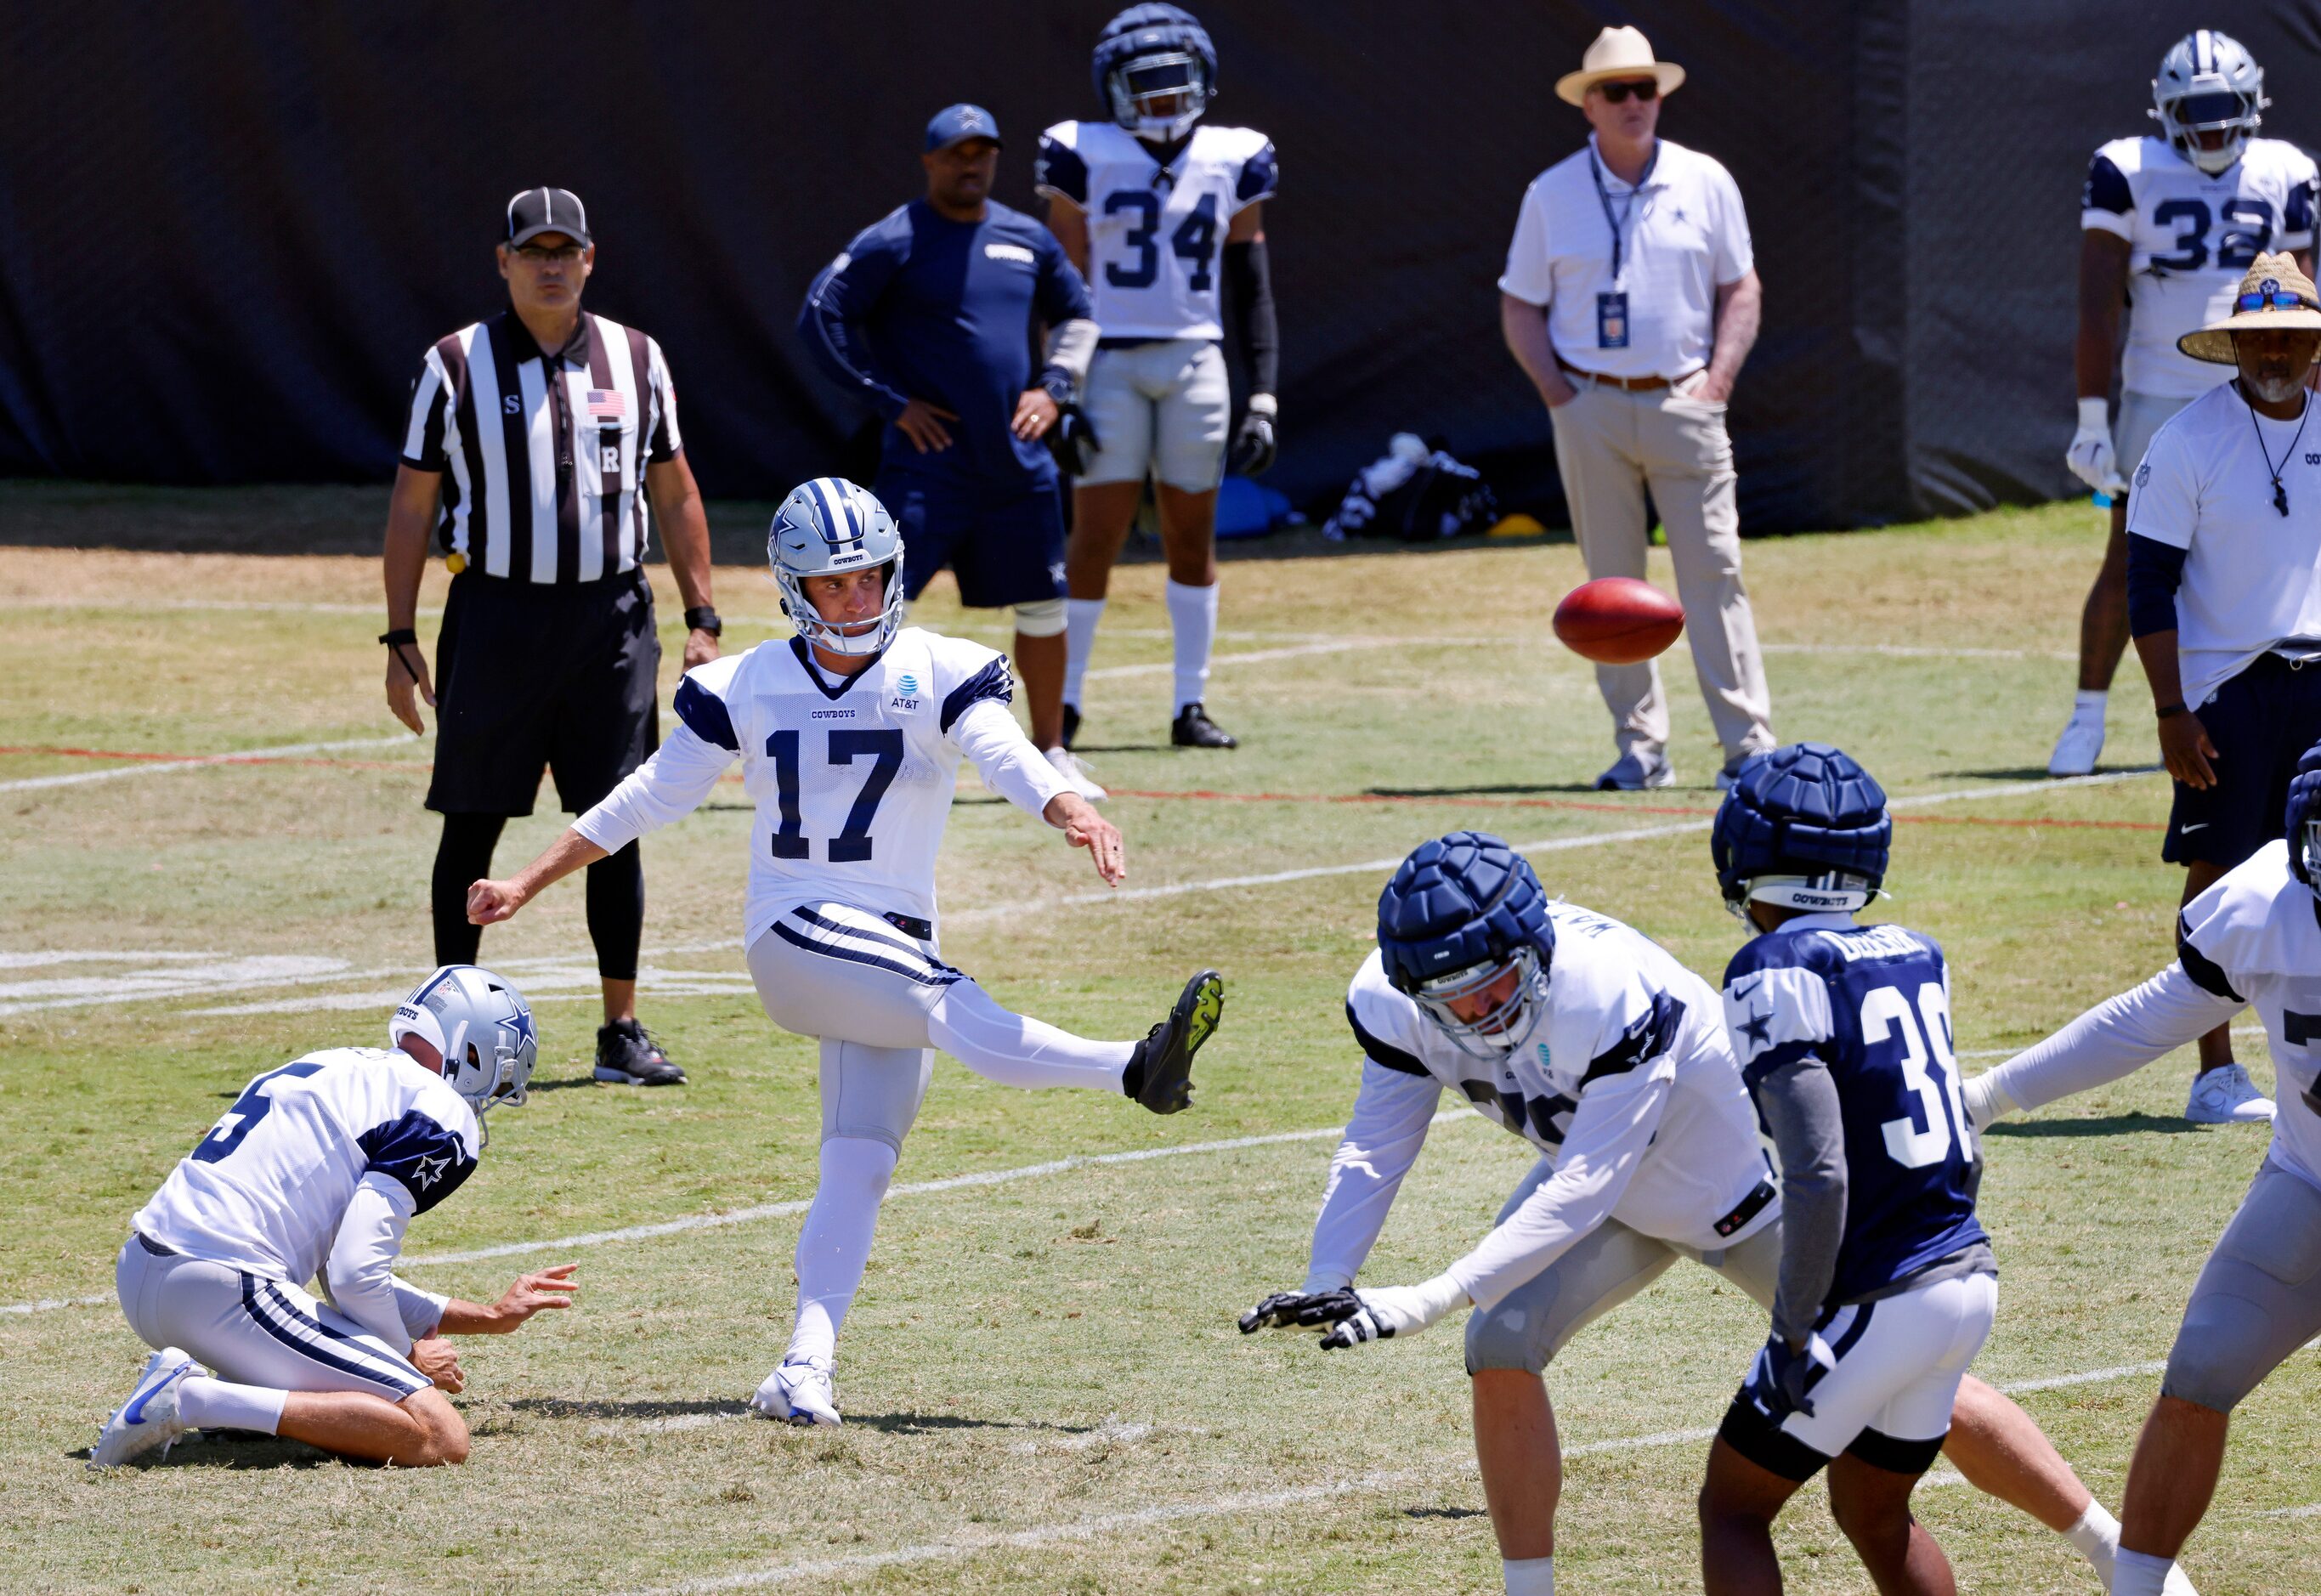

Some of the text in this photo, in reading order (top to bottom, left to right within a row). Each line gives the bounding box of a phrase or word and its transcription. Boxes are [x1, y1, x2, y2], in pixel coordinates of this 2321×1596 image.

[1105, 191, 1216, 291] 34
[2151, 201, 2273, 269] 32
[503, 394, 520, 415] S
[601, 446, 620, 473] R
[834, 554, 863, 565] COWBOYS
[812, 710, 856, 719] COWBOYS
[892, 698, 919, 710] AT&T
[766, 728, 904, 862] 17
[1792, 893, 1848, 906] COWBOYS
[1860, 982, 1974, 1169] 38
[190, 1062, 326, 1164] 5
